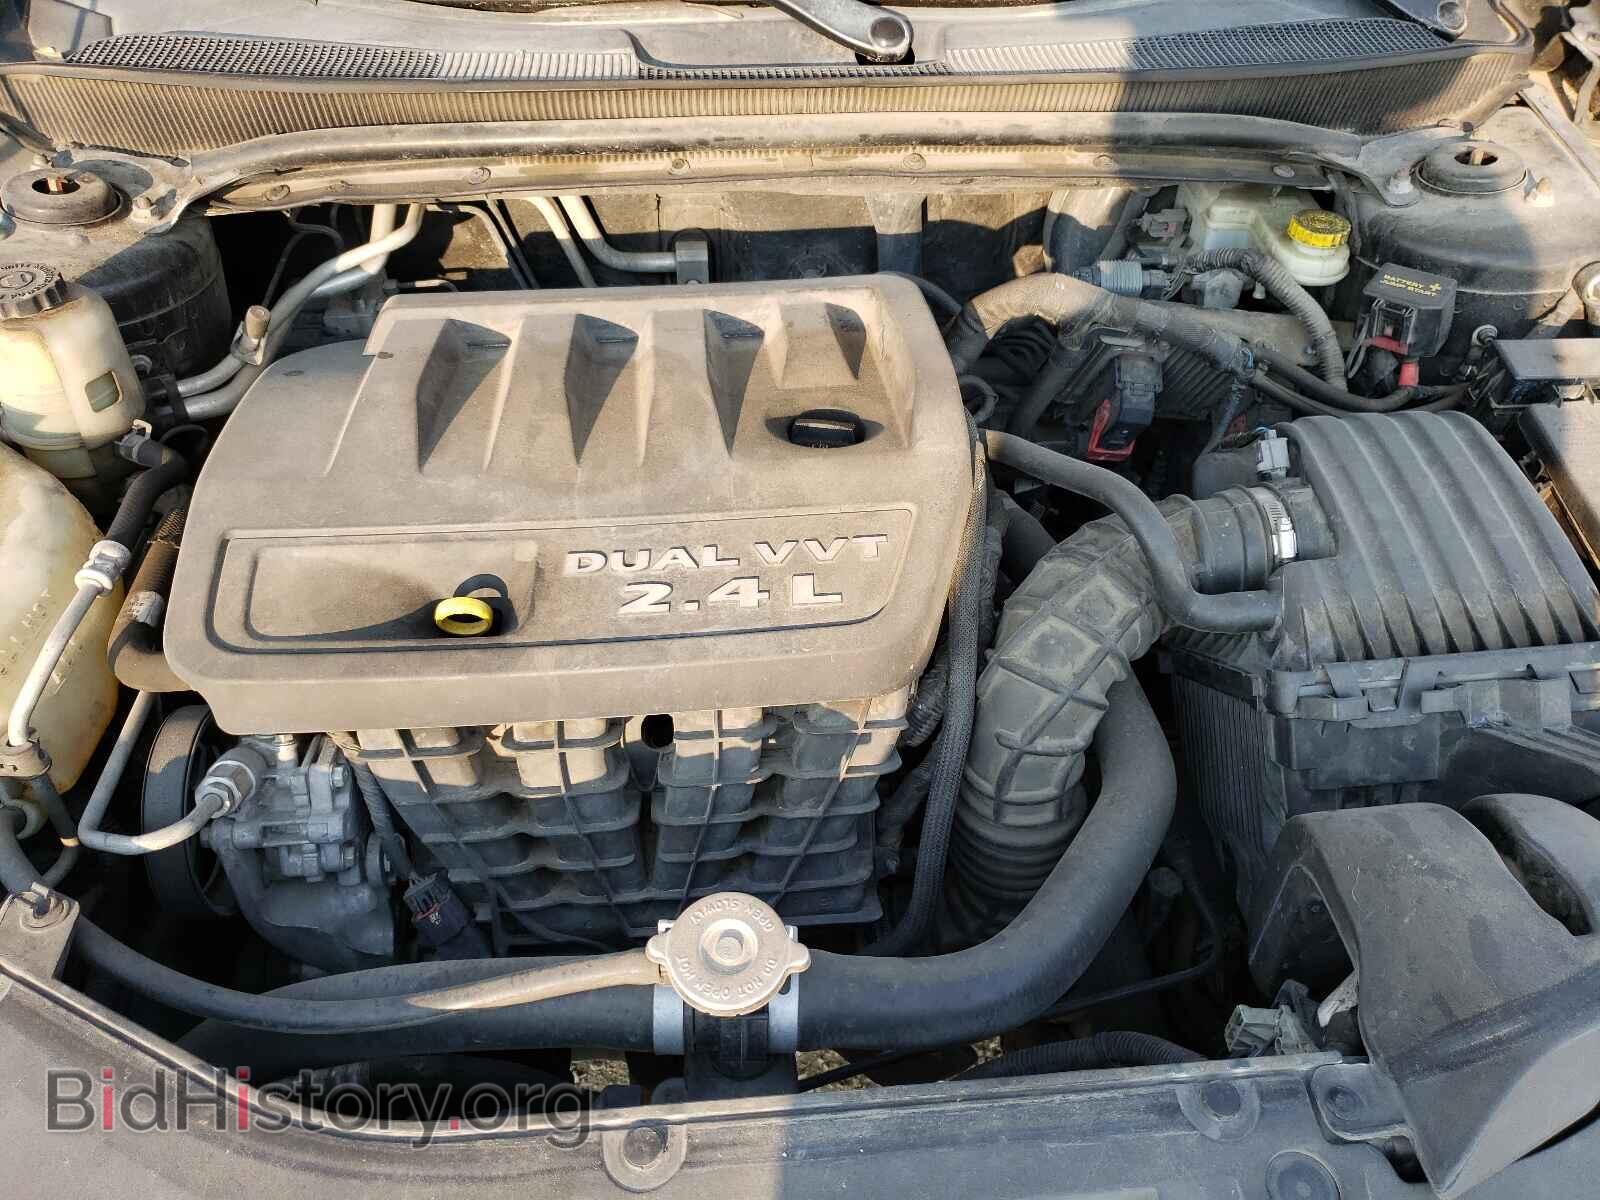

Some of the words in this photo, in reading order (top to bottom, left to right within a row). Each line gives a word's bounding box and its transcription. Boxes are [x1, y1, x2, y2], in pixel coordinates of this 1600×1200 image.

[563, 544, 740, 576] DUAL
[754, 533, 888, 565] VVT
[677, 954, 696, 981] HOT
[764, 958, 778, 977] DO
[695, 981, 731, 999] OPEN
[737, 975, 764, 998] NOT
